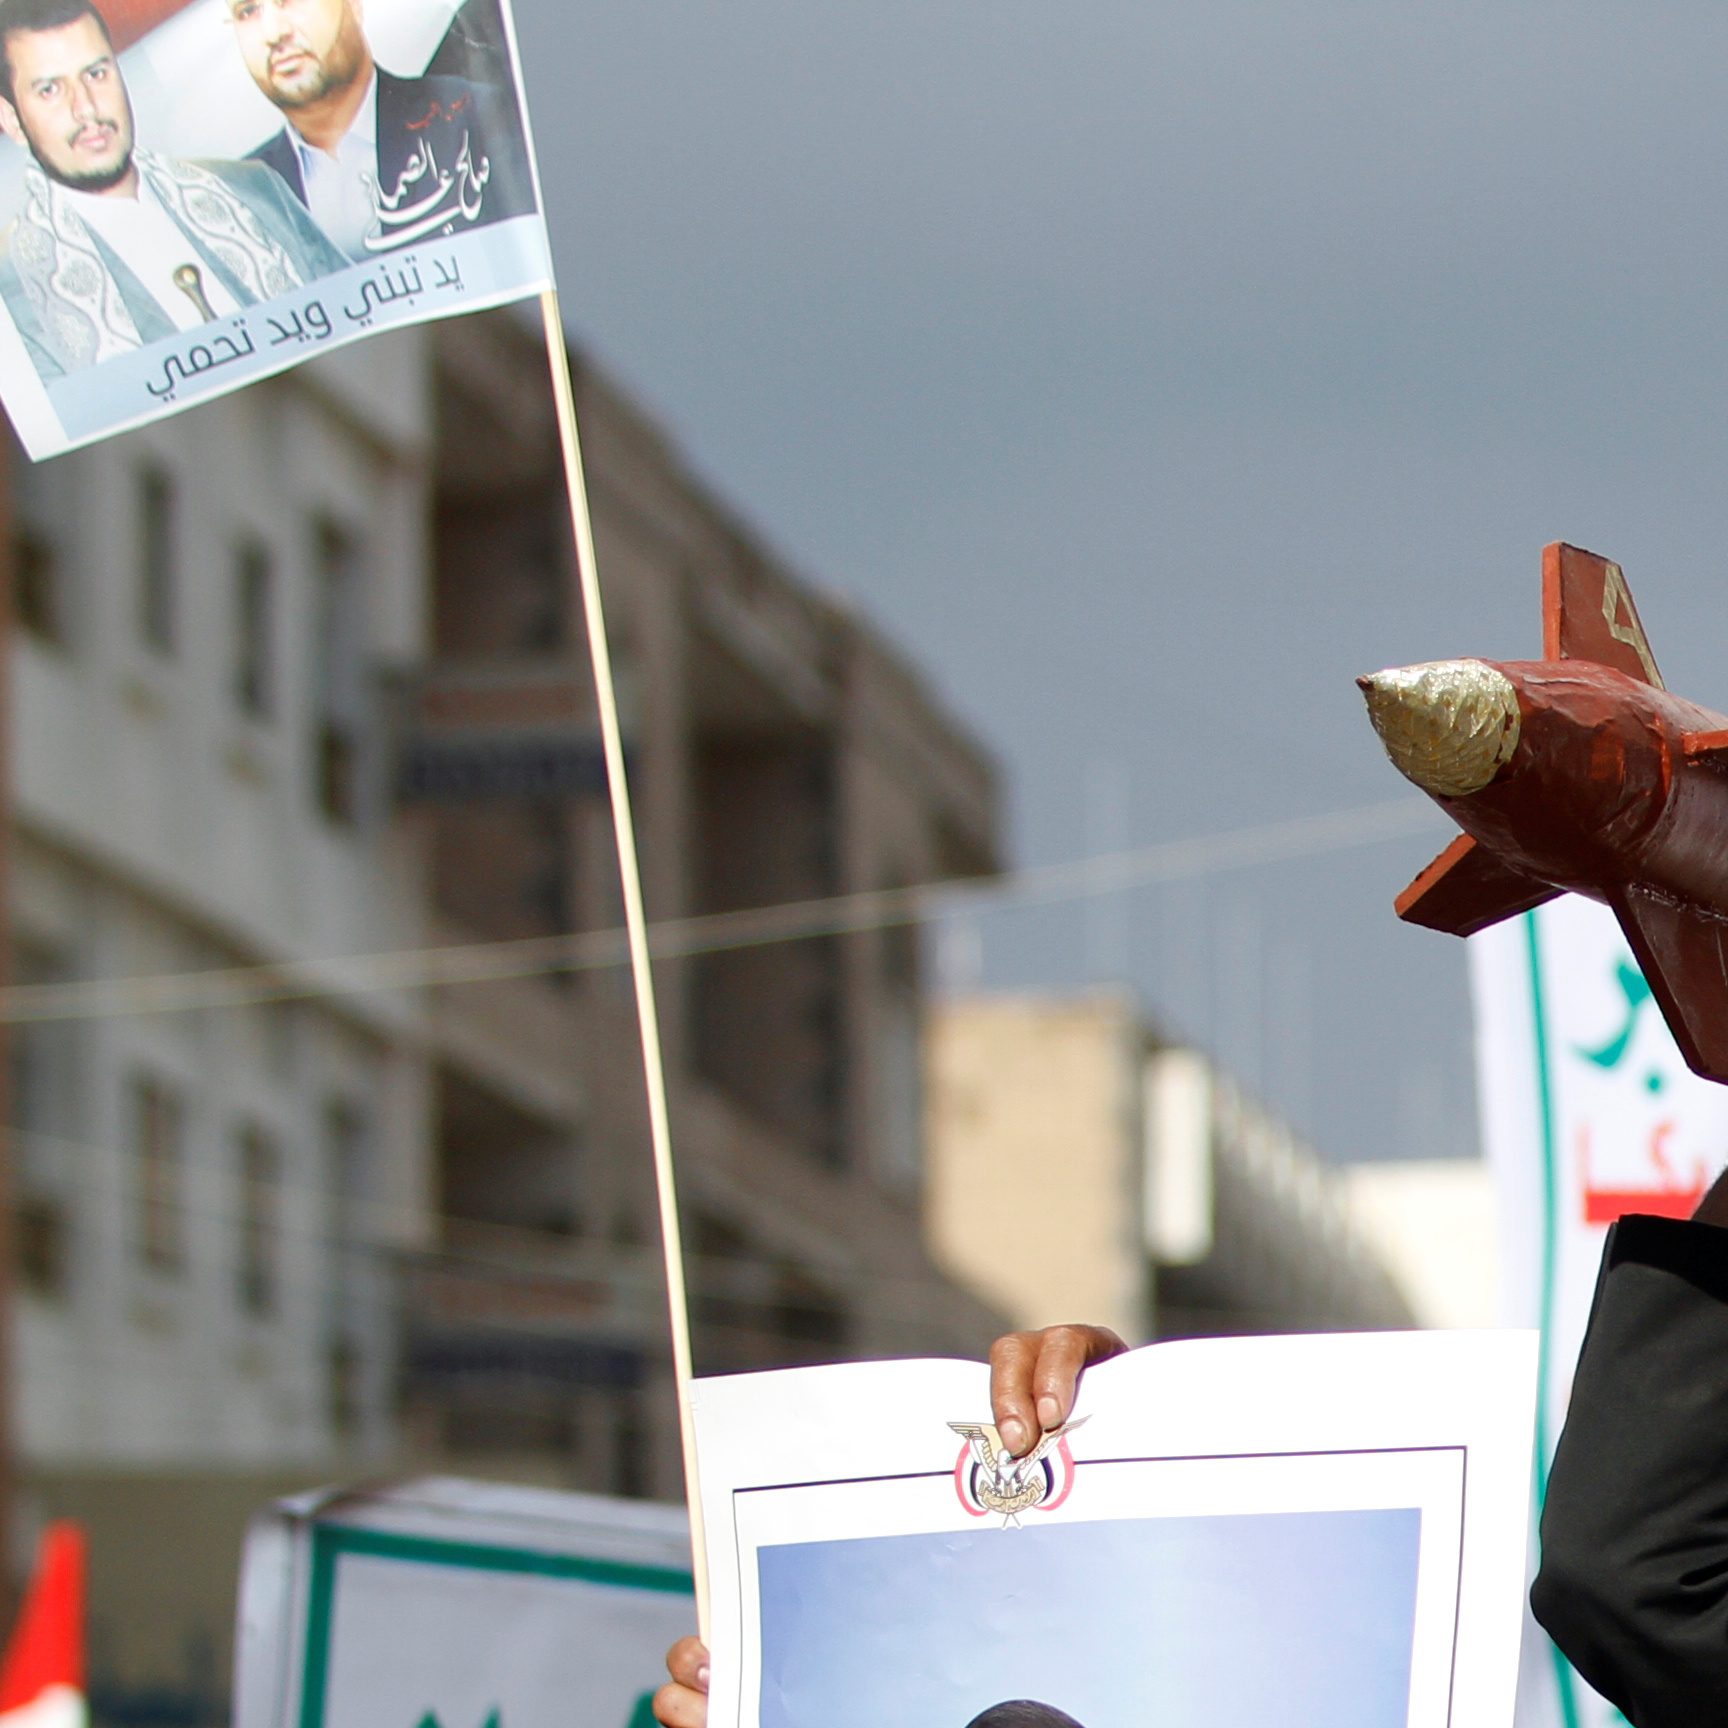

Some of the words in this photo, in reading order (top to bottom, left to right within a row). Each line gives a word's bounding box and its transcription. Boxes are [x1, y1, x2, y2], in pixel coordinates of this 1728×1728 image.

[343, 256, 424, 328] تبني
[433, 255, 465, 292] يد
[266, 299, 333, 347] ويد
[146, 318, 256, 402] تحمي
